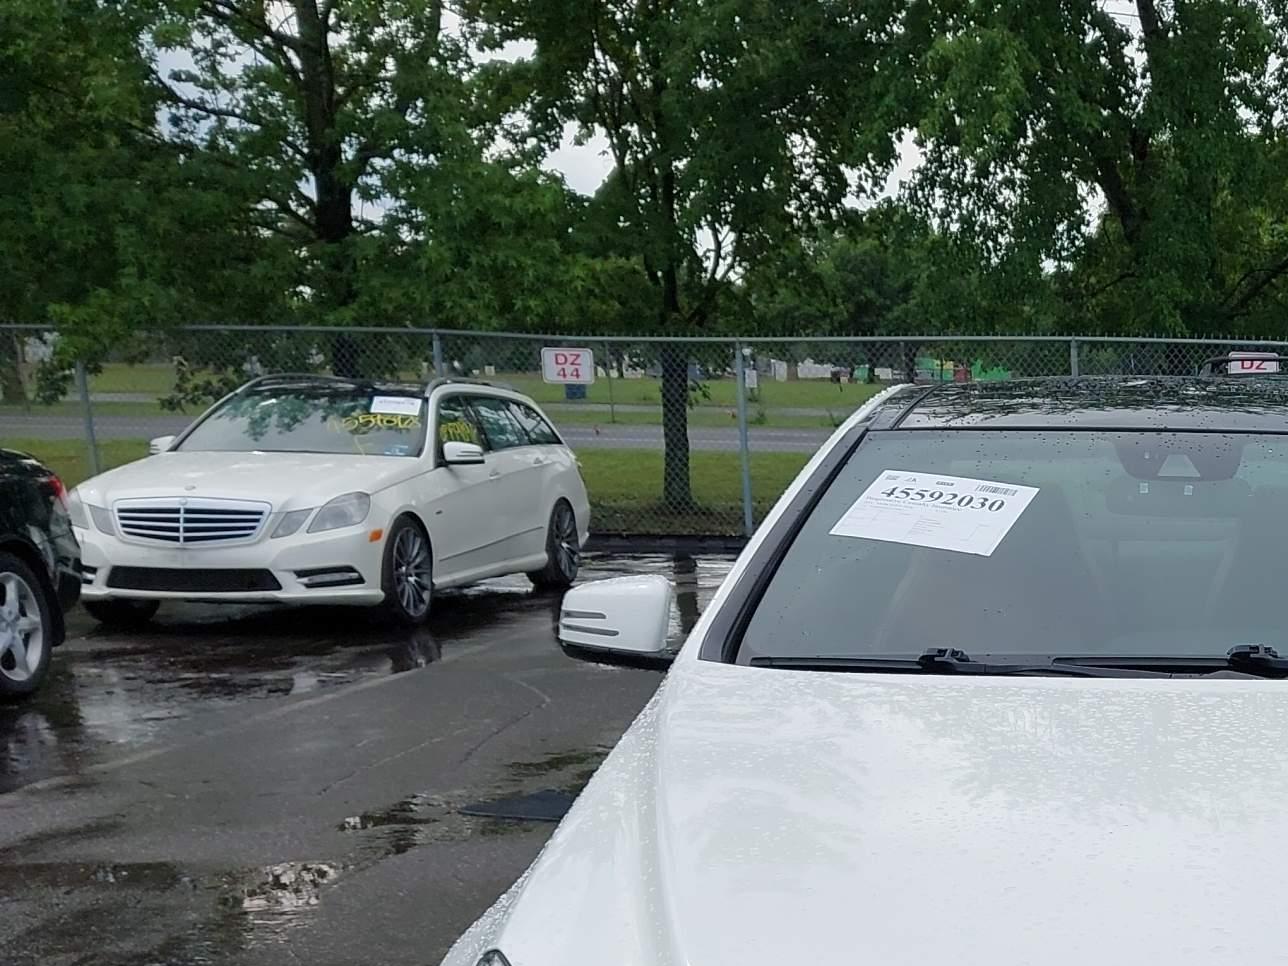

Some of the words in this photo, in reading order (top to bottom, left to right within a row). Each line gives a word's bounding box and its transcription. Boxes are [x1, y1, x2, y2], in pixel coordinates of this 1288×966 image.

[554, 352, 582, 366] DZ
[1240, 359, 1267, 370] DZ
[556, 367, 581, 379] 44
[880, 485, 1006, 513] 45592030
